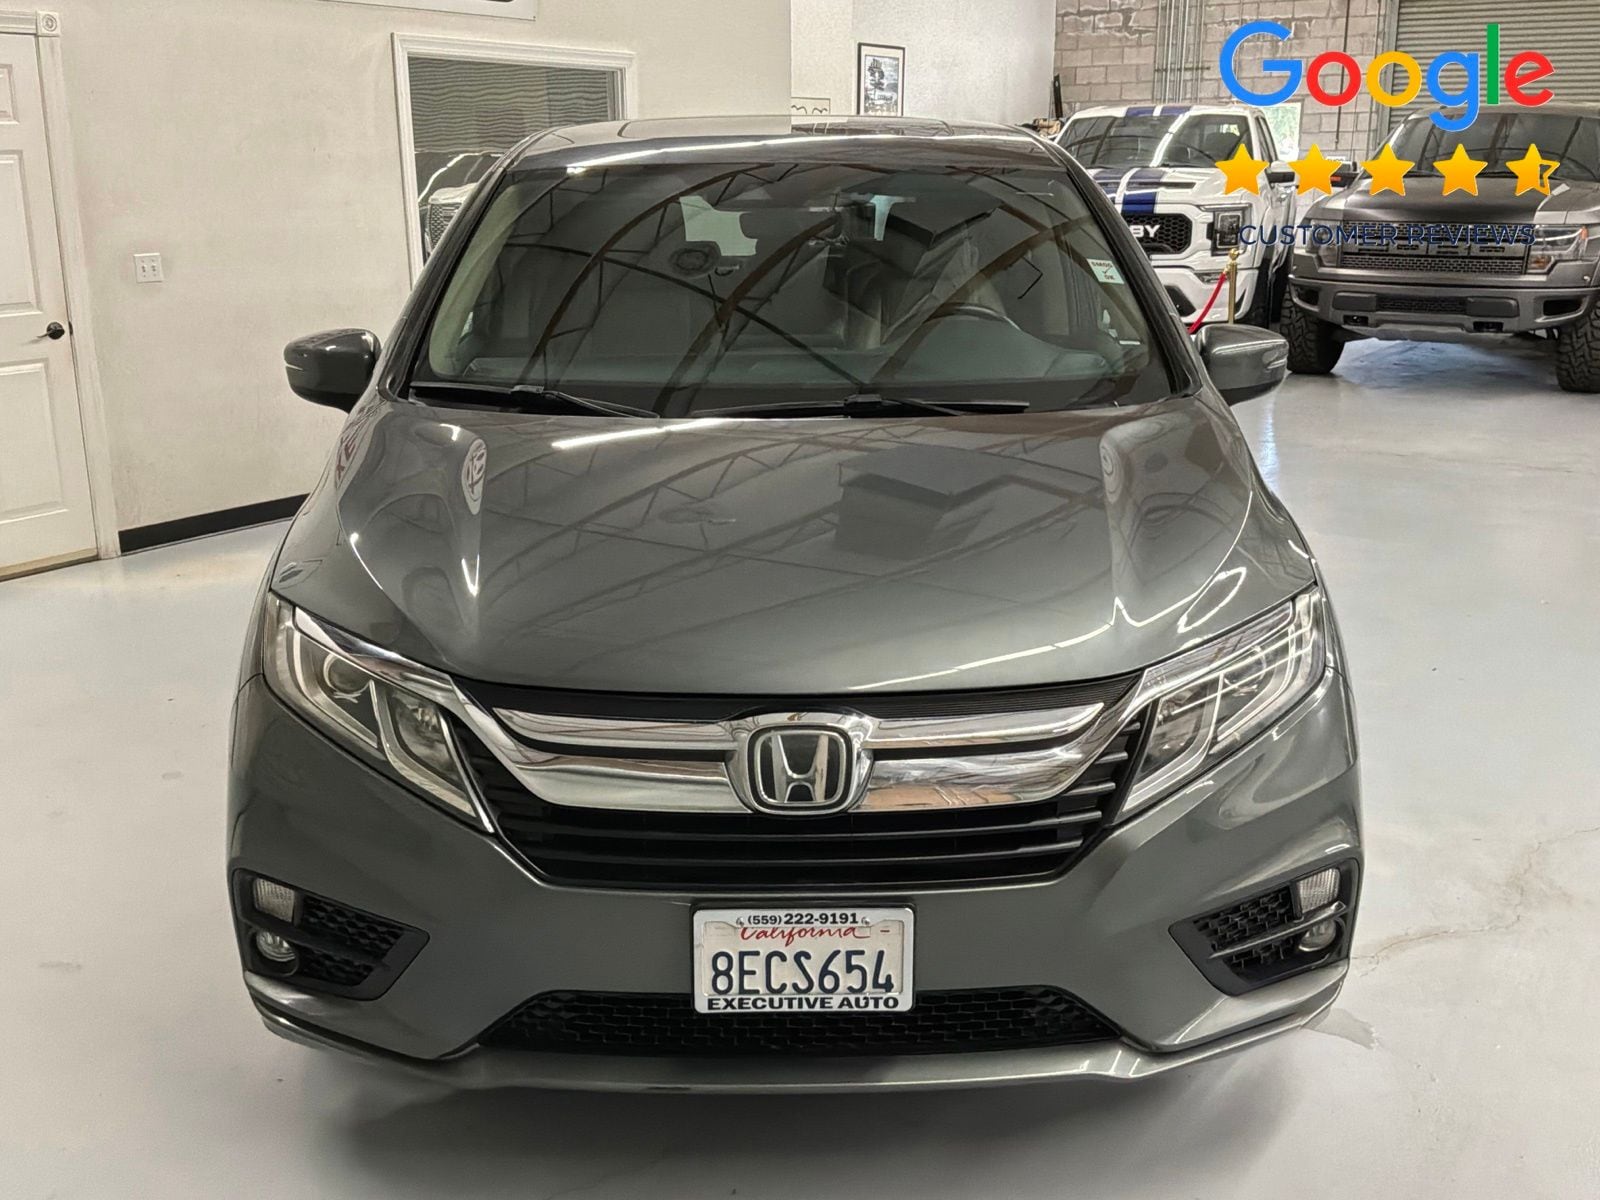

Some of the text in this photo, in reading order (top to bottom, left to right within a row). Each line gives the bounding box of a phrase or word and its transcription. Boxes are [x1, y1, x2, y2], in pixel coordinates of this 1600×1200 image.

[748, 913, 859, 926] (559) 222-9191
[711, 950, 894, 995] 8ECS654
[707, 996, 899, 1011] EXECUTIVE AUTO
